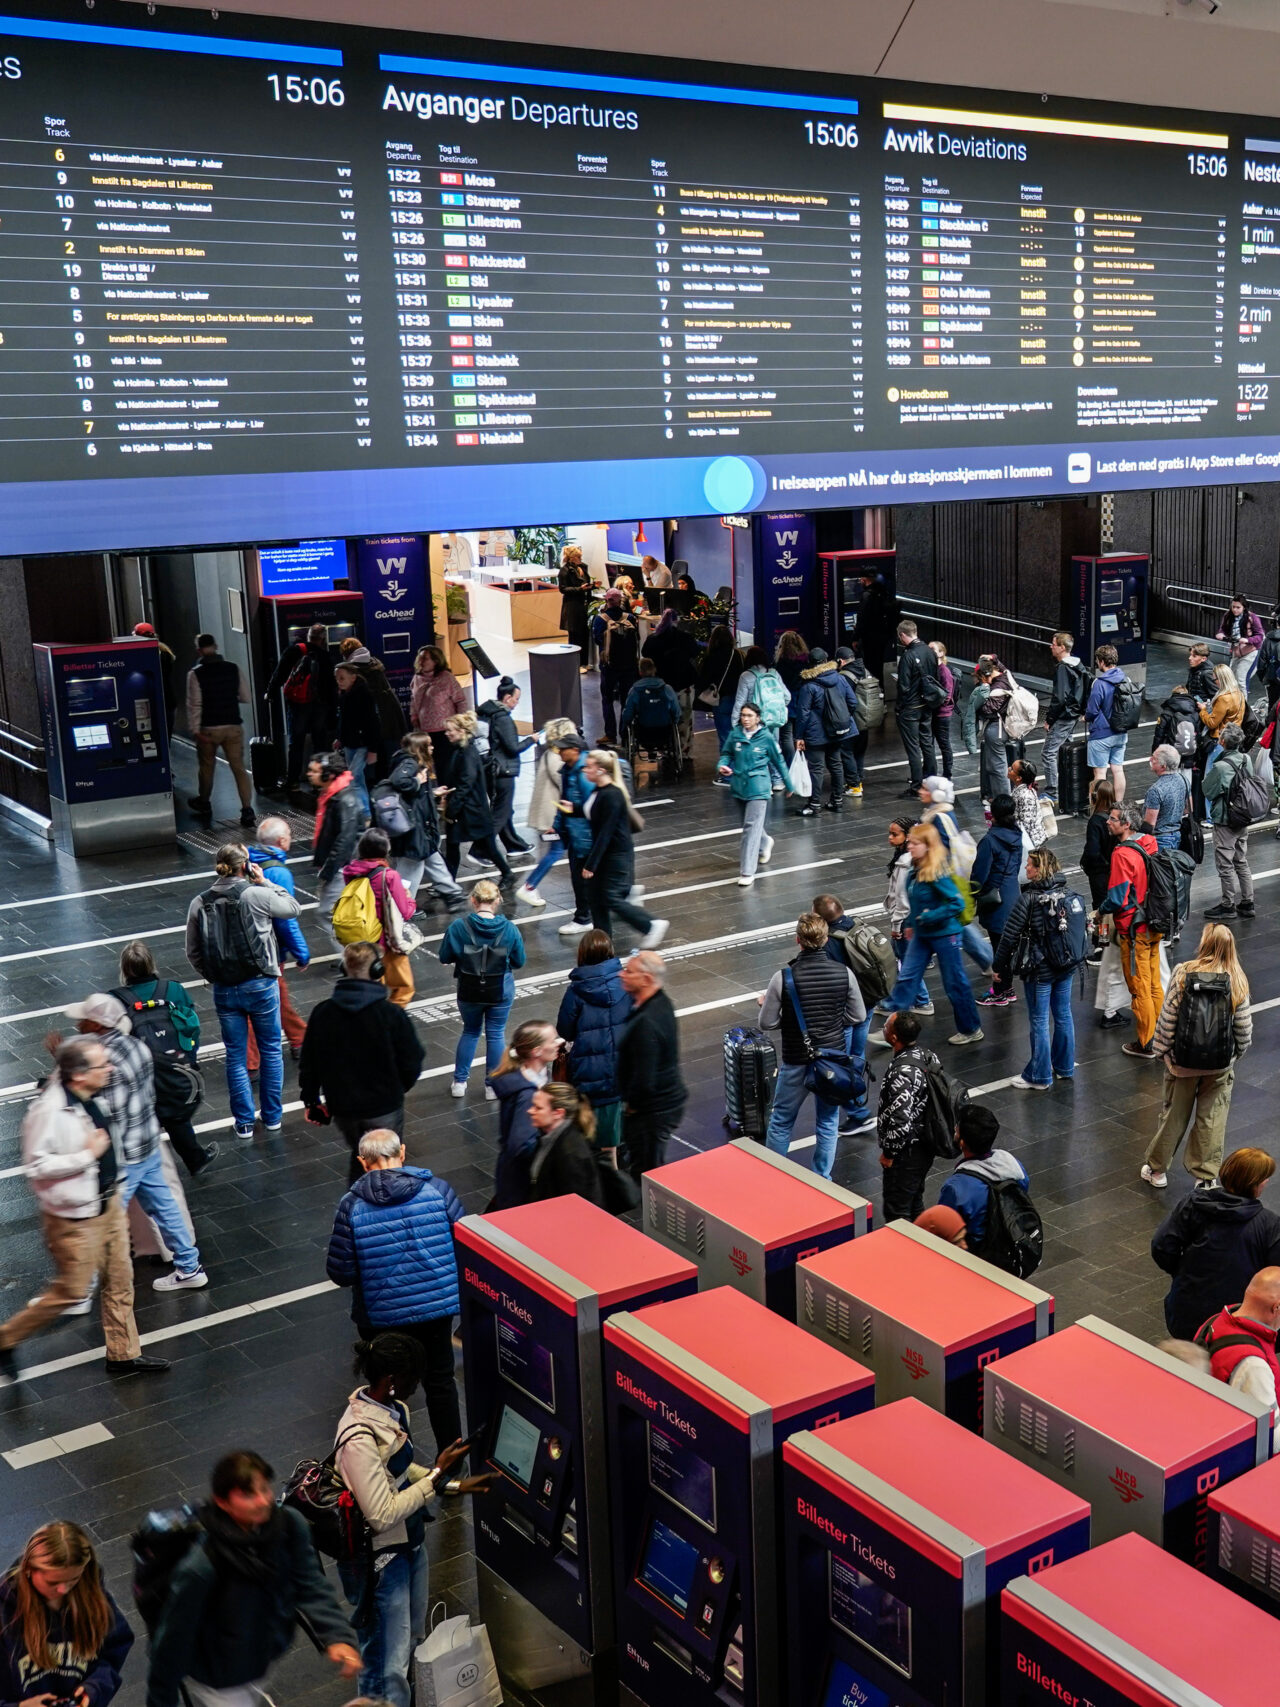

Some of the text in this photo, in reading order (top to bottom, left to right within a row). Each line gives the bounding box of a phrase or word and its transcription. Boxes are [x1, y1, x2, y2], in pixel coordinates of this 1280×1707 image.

[268, 74, 345, 106] 15:06
[383, 84, 638, 130] Avganger Departures
[44, 117, 66, 126] Spor
[46, 128, 70, 137] Track
[804, 121, 858, 148] 15:06
[386, 141, 412, 151] Avgang
[884, 128, 1027, 161] Avvik Deviations
[386, 151, 421, 161] Departure
[440, 154, 478, 164] Destination
[578, 154, 608, 164] Forventet
[578, 164, 606, 173] Expected
[1188, 153, 1228, 177] 15:06
[388, 169, 421, 183] 15:22
[464, 174, 496, 188] Moss
[389, 190, 422, 204] 15:23
[466, 194, 521, 210] Stavanger
[390, 211, 424, 225] 15:26
[1020, 208, 1046, 218] Innstilt
[467, 214, 522, 229] Lillestrøm
[886, 216, 909, 229] 14:36
[392, 232, 425, 245] 15:26
[468, 234, 486, 247] Ski
[1243, 226, 1274, 243] 1 min
[394, 252, 426, 266] 15:30
[470, 254, 526, 269] Rakkestad
[1020, 256, 1046, 268] Innstilt
[395, 273, 426, 286] 15:31
[470, 274, 488, 288] Ski
[397, 294, 428, 306] 15:31
[1020, 289, 1046, 300] Innstilt
[1020, 306, 1046, 317] Innstilt
[1240, 306, 1272, 322] 2 min
[398, 314, 430, 327] 15:33
[473, 314, 504, 327] Skien
[886, 320, 909, 332] 15:11
[400, 334, 432, 347] 15:36
[474, 334, 492, 347] Ski
[1020, 338, 1046, 349] Innstilt
[401, 354, 432, 368] 15:37
[476, 355, 520, 368] Stabekk
[1020, 354, 1046, 366] Innstilt
[402, 374, 434, 387] 15:39
[476, 374, 508, 386] Skien
[900, 390, 948, 400] Hovedbanen
[1238, 384, 1268, 400] 15:22
[404, 394, 434, 408] 15:41
[478, 393, 536, 408] Spikkestad
[405, 414, 436, 428] 15:41
[479, 413, 532, 426] Lillestrøm
[406, 434, 438, 448] 15:44
[480, 432, 524, 444] Hakadal
[1096, 460, 1117, 474] Last
[1118, 459, 1136, 472] den
[1138, 458, 1157, 472] ned
[1158, 456, 1184, 473] gratis
[1190, 456, 1209, 471] App
[1210, 454, 1234, 468] Store
[1235, 453, 1254, 466] eller
[772, 464, 1052, 492] I reiseappen NÅ har du stasjonsskjermen i lommen
[366, 538, 380, 546] Train
[400, 536, 416, 544] from
[775, 530, 798, 546] VY
[783, 550, 791, 560] SJ
[376, 556, 407, 576] VY
[388, 580, 398, 590] SJ
[772, 575, 803, 584] GoAhead
[374, 608, 414, 620] GoAhead
[64, 660, 126, 672] Billetter Tickets
[732, 1246, 748, 1264] NSB
[465, 1268, 533, 1326] Billetter Tickets
[906, 1346, 924, 1366] NSB
[616, 1370, 697, 1440] Billetter Tickets
[1116, 1466, 1137, 1489] NSB
[796, 1498, 896, 1580] Billetter Tickets
[627, 1643, 650, 1672] ENTUR
[1016, 1652, 1080, 1707] Billetter
[850, 1683, 868, 1704] Buy
